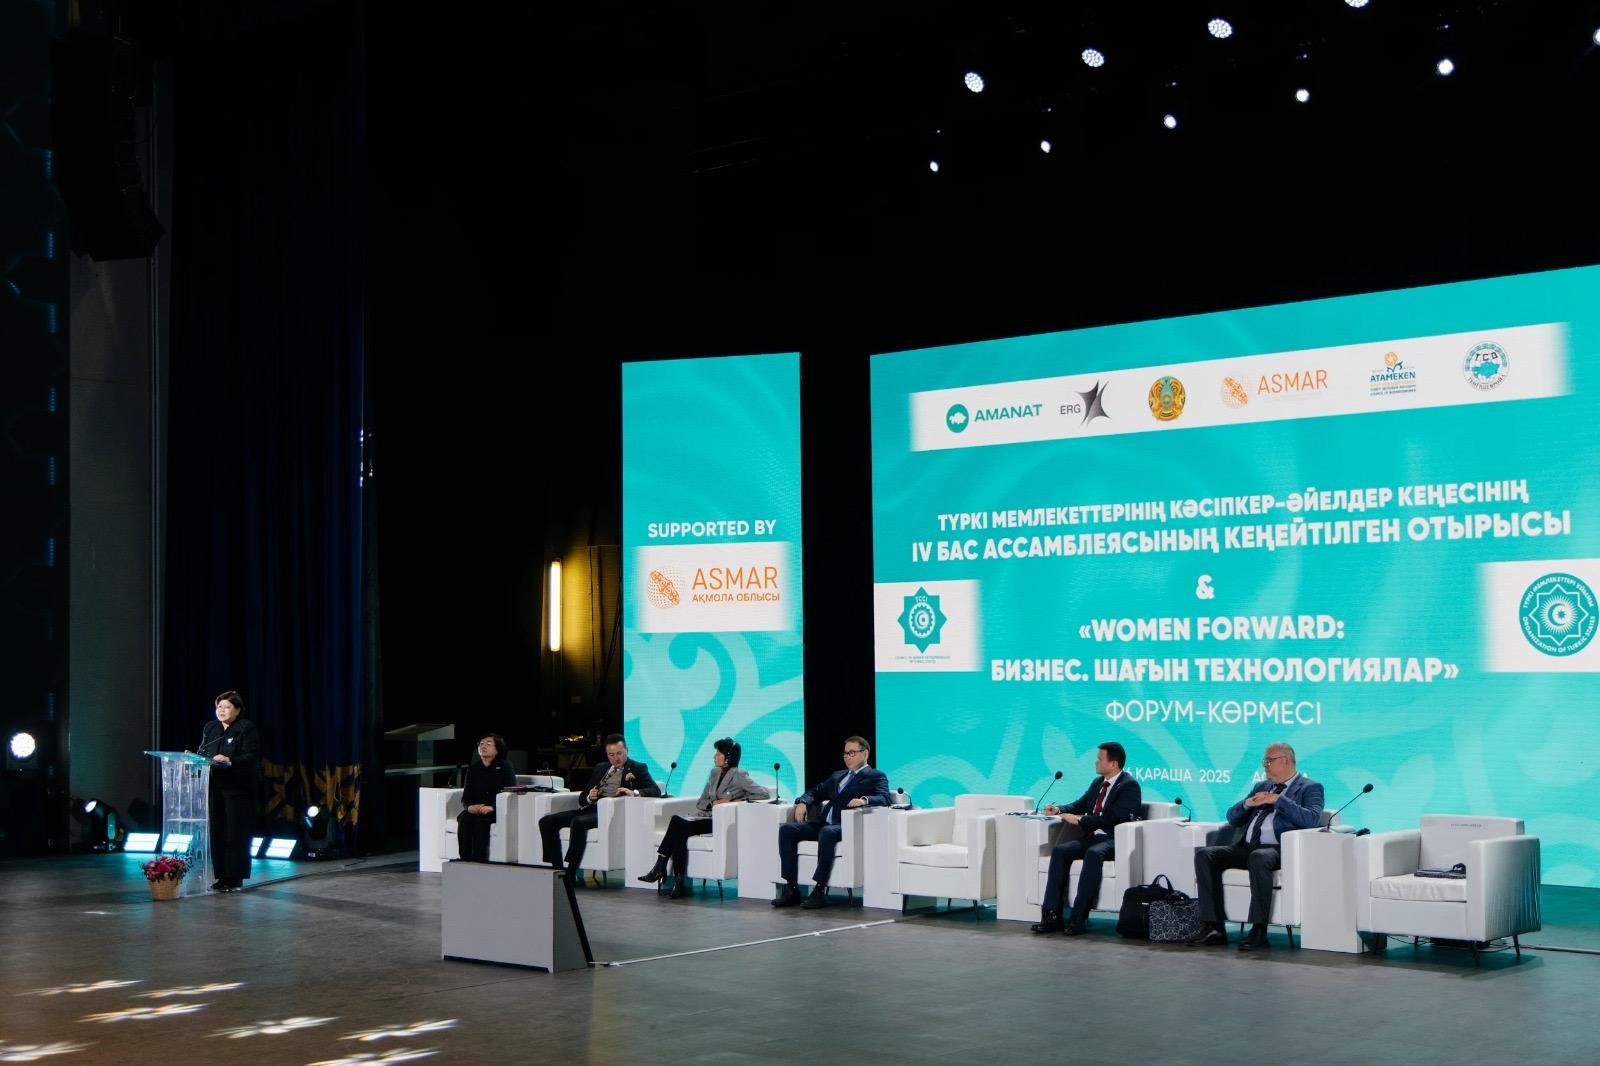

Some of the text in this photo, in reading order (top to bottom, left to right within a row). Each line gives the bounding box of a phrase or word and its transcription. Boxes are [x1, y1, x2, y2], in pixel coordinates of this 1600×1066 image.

[1257, 369, 1328, 395] ASMAR
[1370, 372, 1415, 382] ATAMEKEN
[974, 404, 1042, 422] AMANAT
[1060, 403, 1081, 415] ERG
[938, 480, 1529, 530] ТҮРКІ МЕМЛЕКЕТТЕРІНІҢ КӘСІПКЕР-ӘЙЕЛДЕР КЕҢЕСІНІҢ
[648, 519, 776, 538] SUPPORTED BY
[913, 511, 1570, 561] IV БАС АССАМБЛЕЯСЫНЫҢ КЕҢЕЙТІЛГЕН ОТЫРЫСЫ
[692, 566, 778, 590] ASMAR
[1196, 575, 1214, 599] &
[692, 592, 780, 603] АҚМОЛА ОБЛЫСЫ
[1079, 615, 1344, 641] «WOMEN FORWARD:
[992, 658, 1458, 682] БИЗНЕС. ШАҒЫН ТЕХНОЛОГИЯЛАР»
[1106, 701, 1320, 724] ФОРУМ-КӨРМЕСІ
[1136, 768, 1192, 783] ҚАРАША
[1199, 769, 1230, 783] 2025
